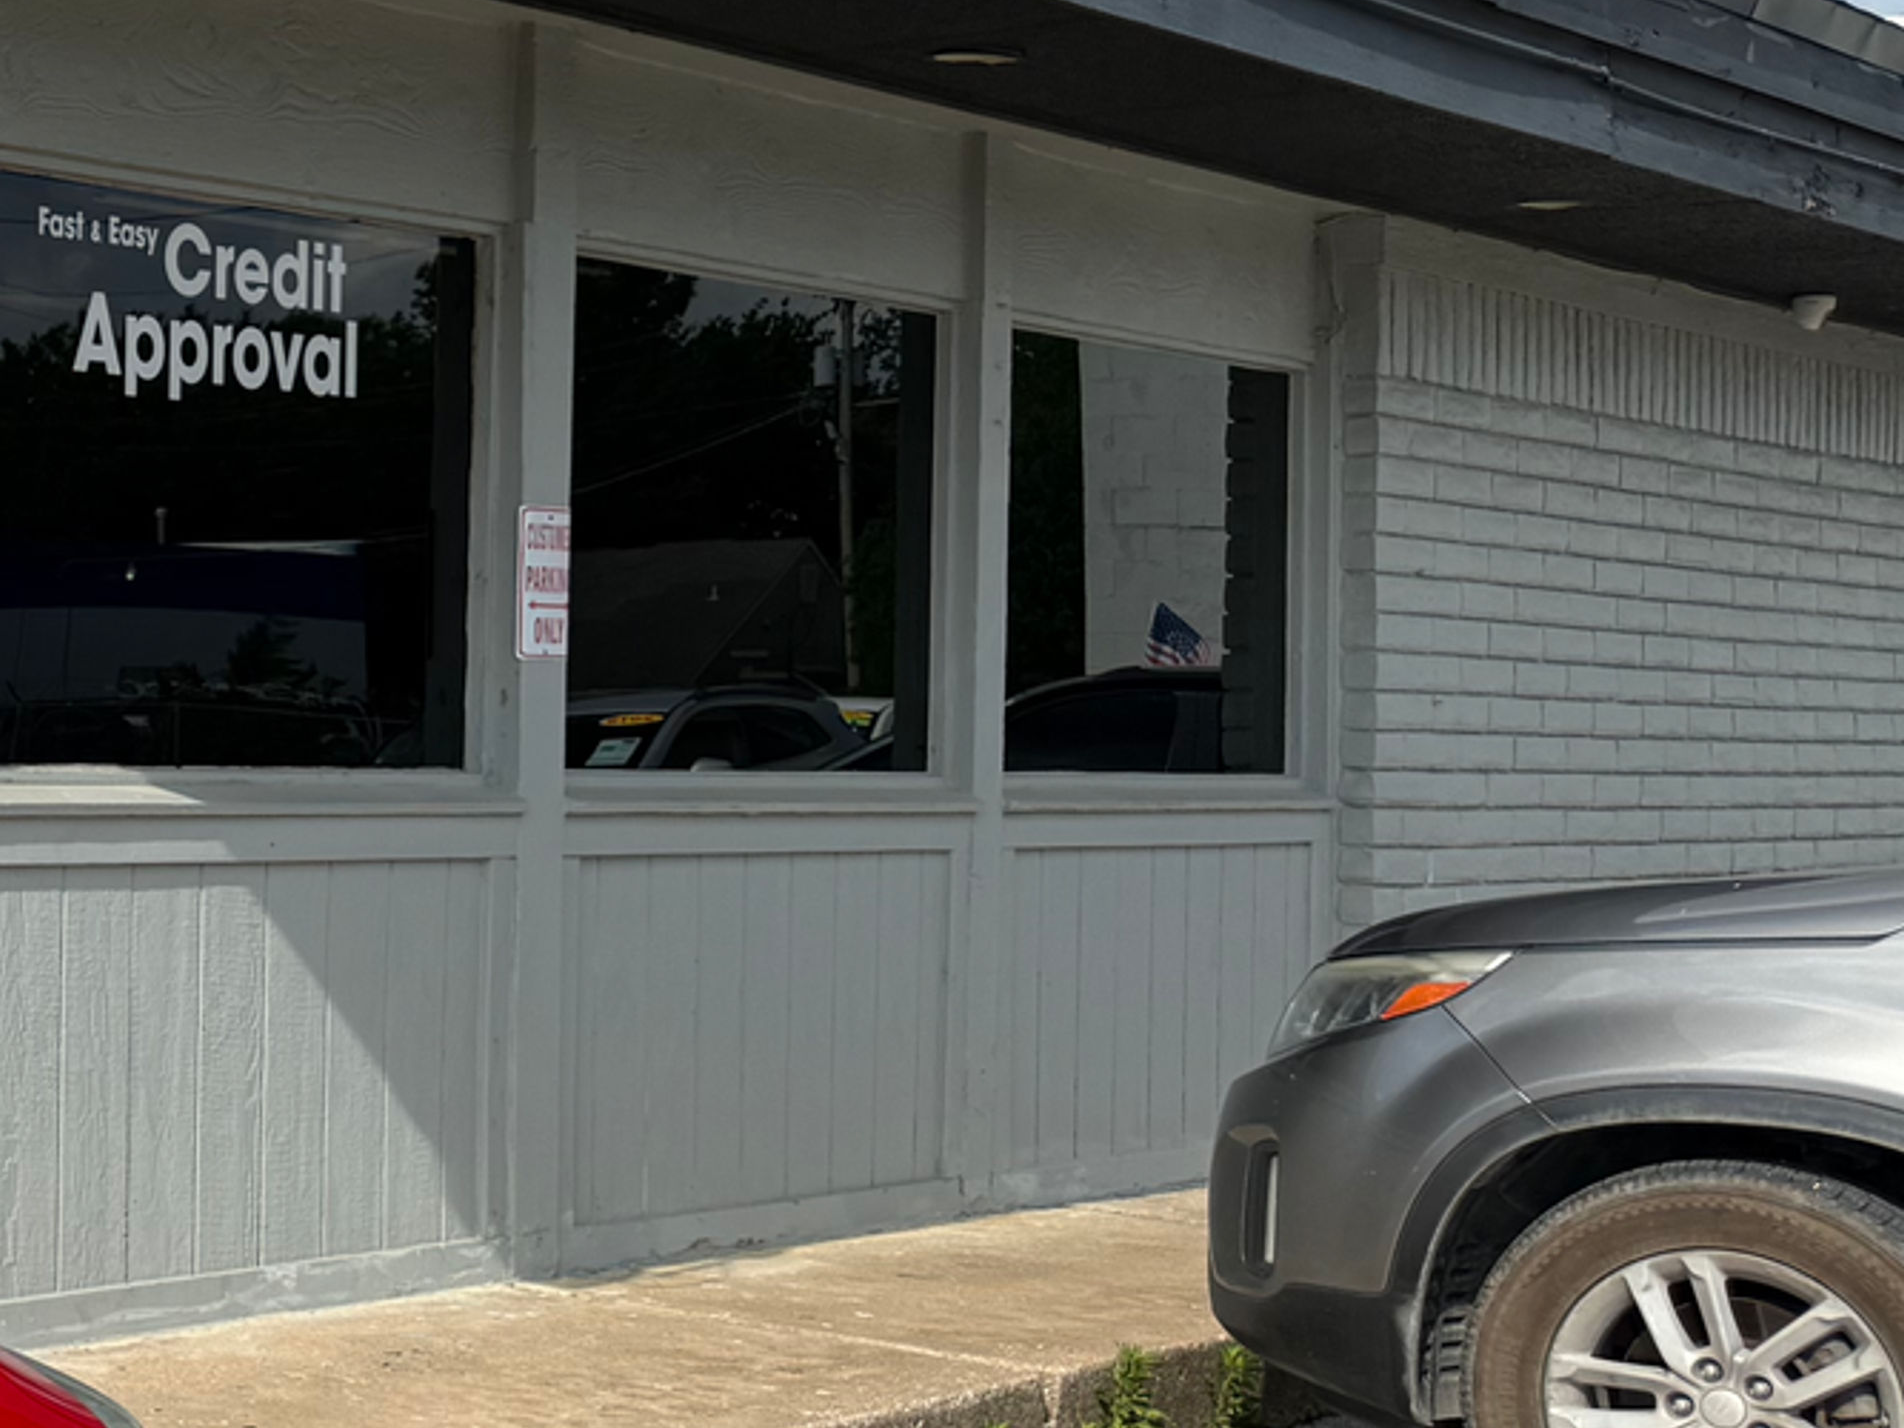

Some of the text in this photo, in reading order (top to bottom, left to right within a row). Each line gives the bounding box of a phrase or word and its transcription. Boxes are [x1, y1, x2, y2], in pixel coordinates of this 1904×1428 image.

[38, 205, 347, 312] Fast & Easy Credit
[73, 291, 358, 401] Approval
[528, 523, 570, 550] CUSTOME
[527, 565, 568, 593] PARKIN
